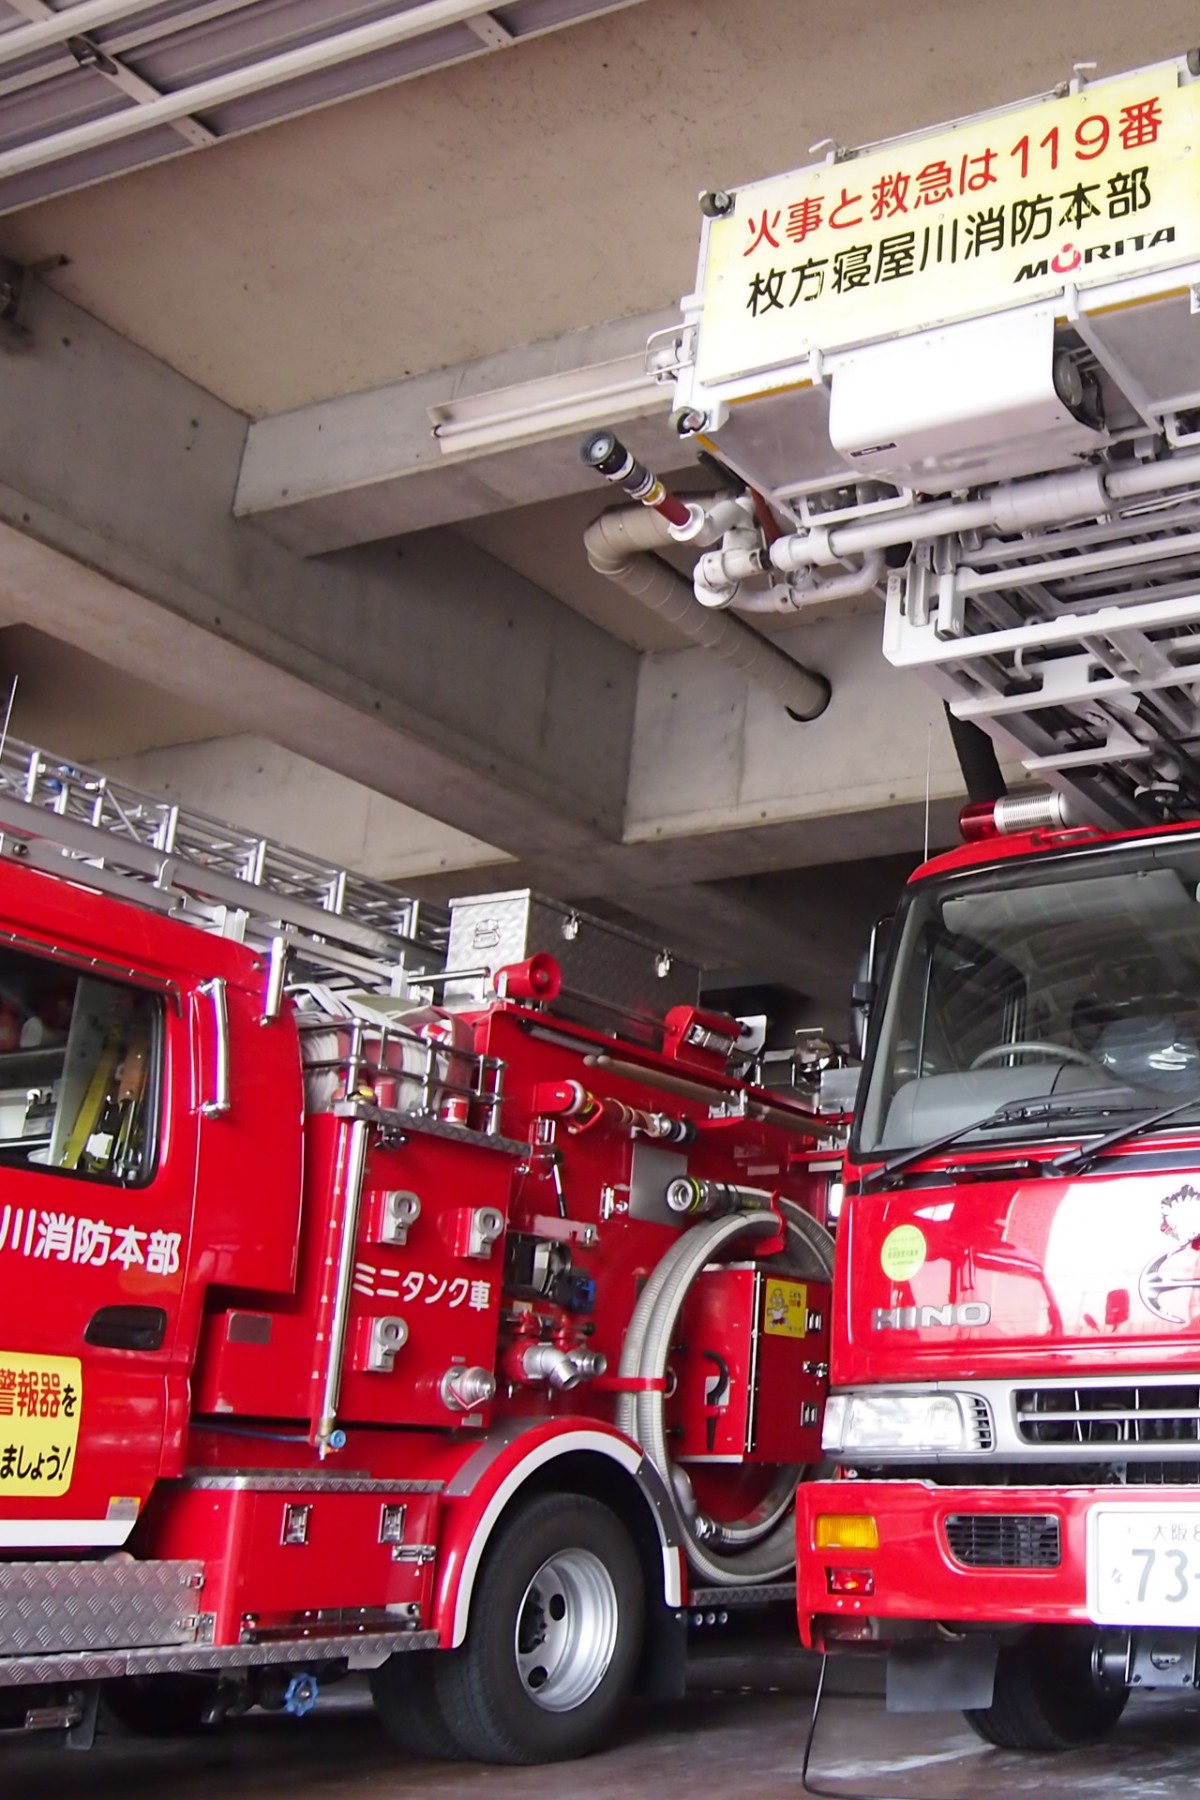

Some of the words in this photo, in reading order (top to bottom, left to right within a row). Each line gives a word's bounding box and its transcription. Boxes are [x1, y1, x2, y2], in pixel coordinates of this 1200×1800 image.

[743, 97, 1162, 257] 火事と救急は119番
[746, 166, 1151, 317] 枚方寝屋川消防本部
[1013, 226, 1175, 283] MORITA
[0, 1205, 182, 1276] 川消防本部
[353, 1262, 491, 1312] ミニタンク車
[872, 1302, 991, 1329] HINO
